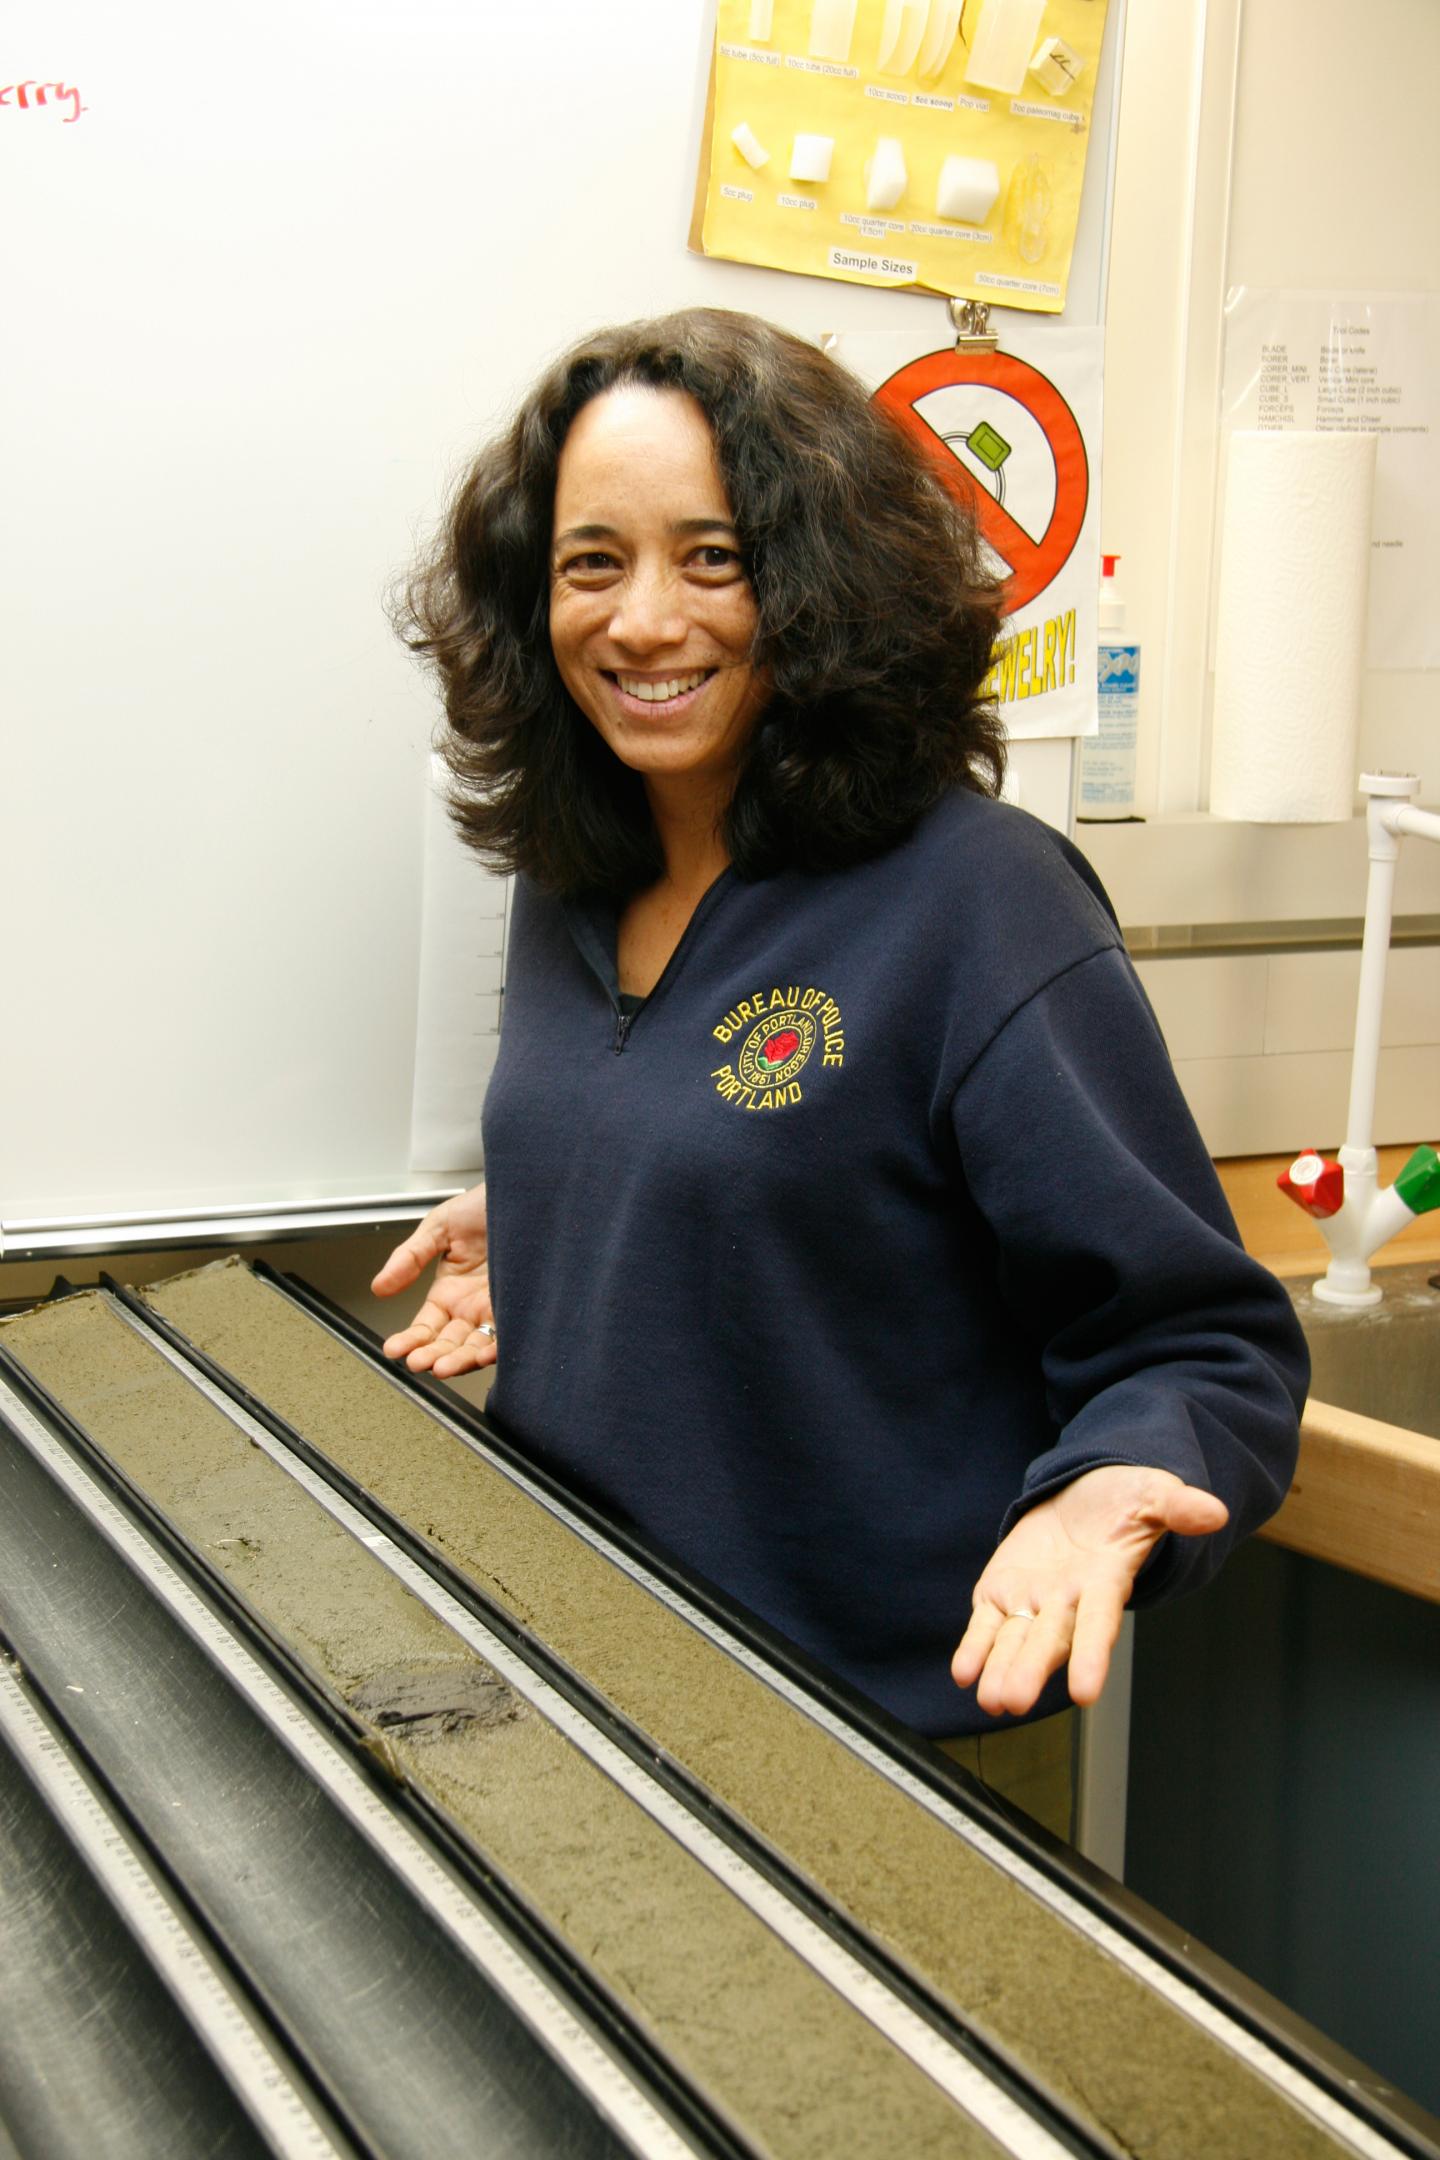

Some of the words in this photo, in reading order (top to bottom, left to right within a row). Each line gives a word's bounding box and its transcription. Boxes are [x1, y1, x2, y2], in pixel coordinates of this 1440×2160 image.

[738, 191, 753, 202] plug
[782, 196, 799, 206] 10cc
[800, 199, 816, 210] plug
[844, 214, 861, 225] 10cc
[861, 217, 887, 229] quarter
[888, 222, 905, 231] core
[911, 223, 928, 235] 20cc
[929, 227, 954, 239] quarter
[954, 230, 972, 239] core
[833, 252, 878, 273] Sample
[881, 259, 914, 276] Sizes
[995, 277, 1021, 289] quarter
[1022, 282, 1037, 291] core
[712, 986, 800, 1043] BUREAU
[800, 988, 826, 1010] OF
[816, 998, 845, 1068] POLICE
[748, 1033, 763, 1049] OF
[743, 1051, 755, 1076] CITY
[775, 1038, 813, 1083] OREGON
[710, 1064, 802, 1110] PORTLAND
